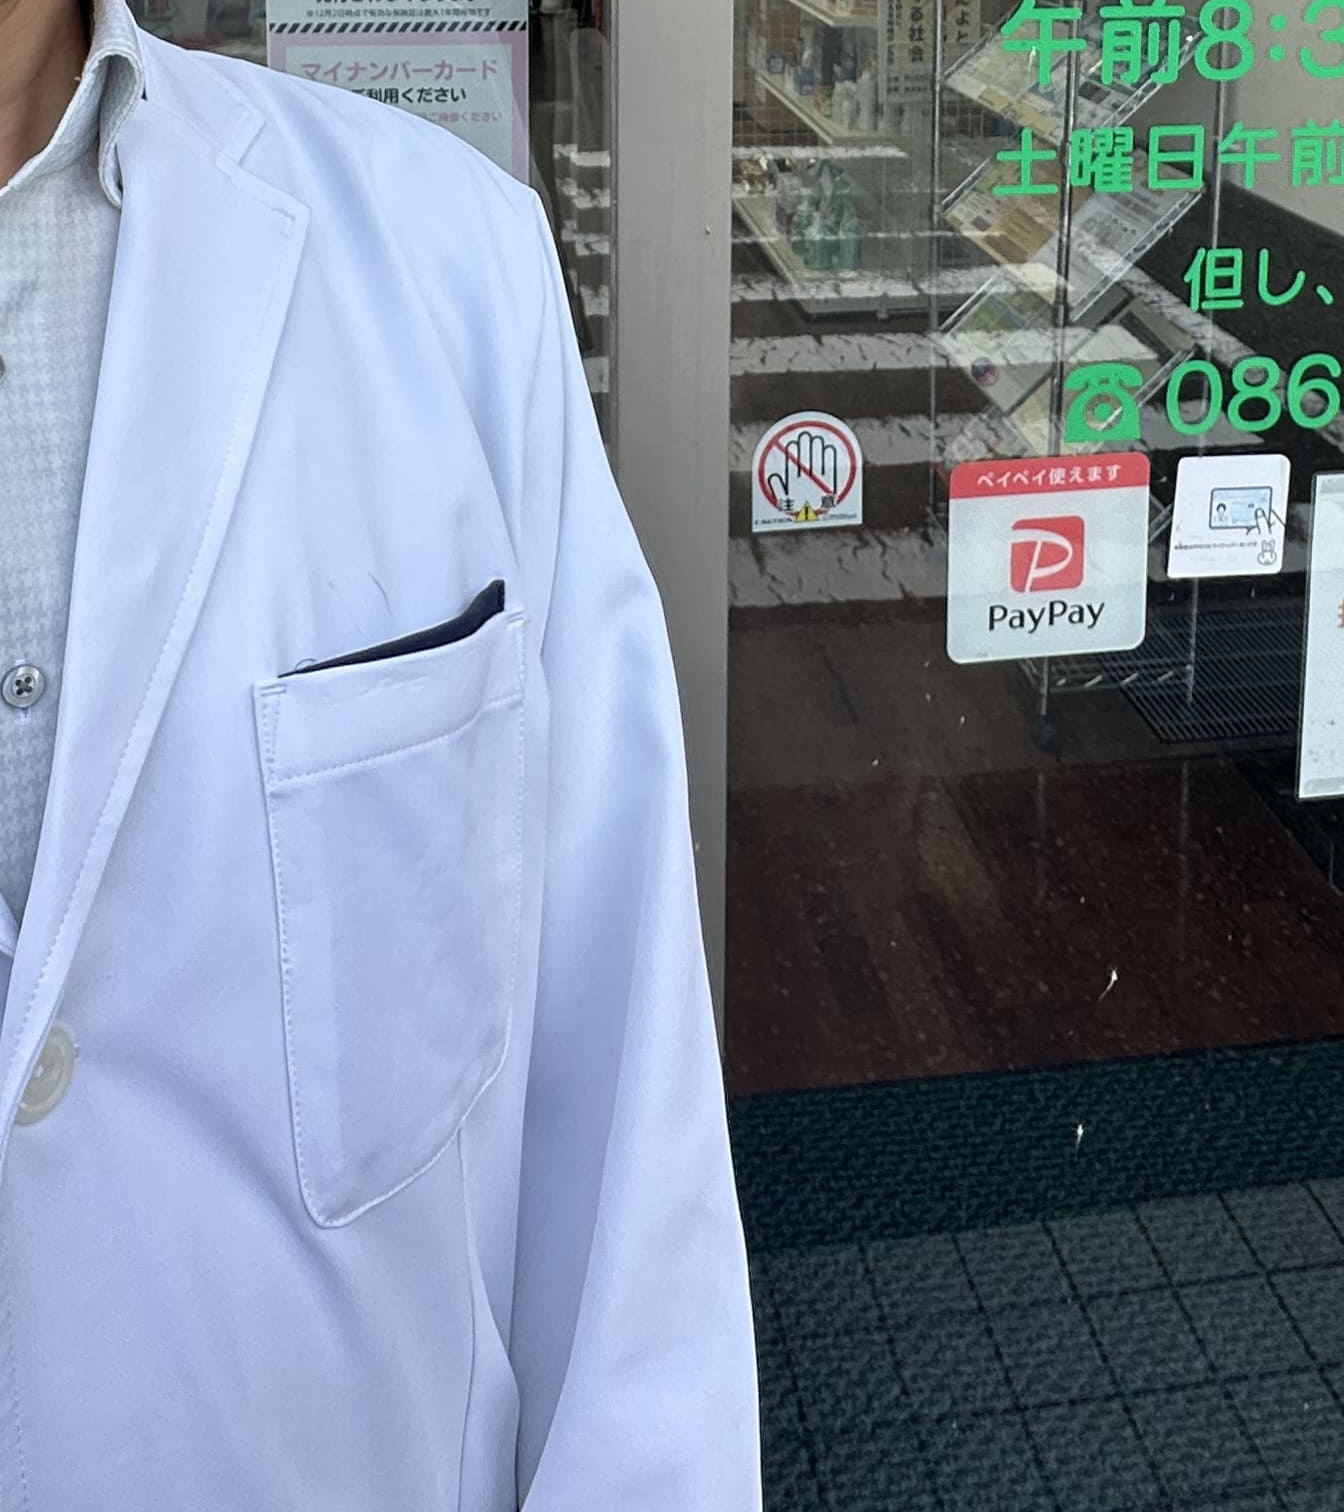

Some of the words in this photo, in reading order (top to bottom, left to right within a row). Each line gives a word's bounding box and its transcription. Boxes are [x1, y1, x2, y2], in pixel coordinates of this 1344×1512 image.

[301, 59, 498, 81] マイナンバーカード
[976, 465, 1122, 486] ペイペイ使えます
[988, 600, 1105, 632] PayPay
